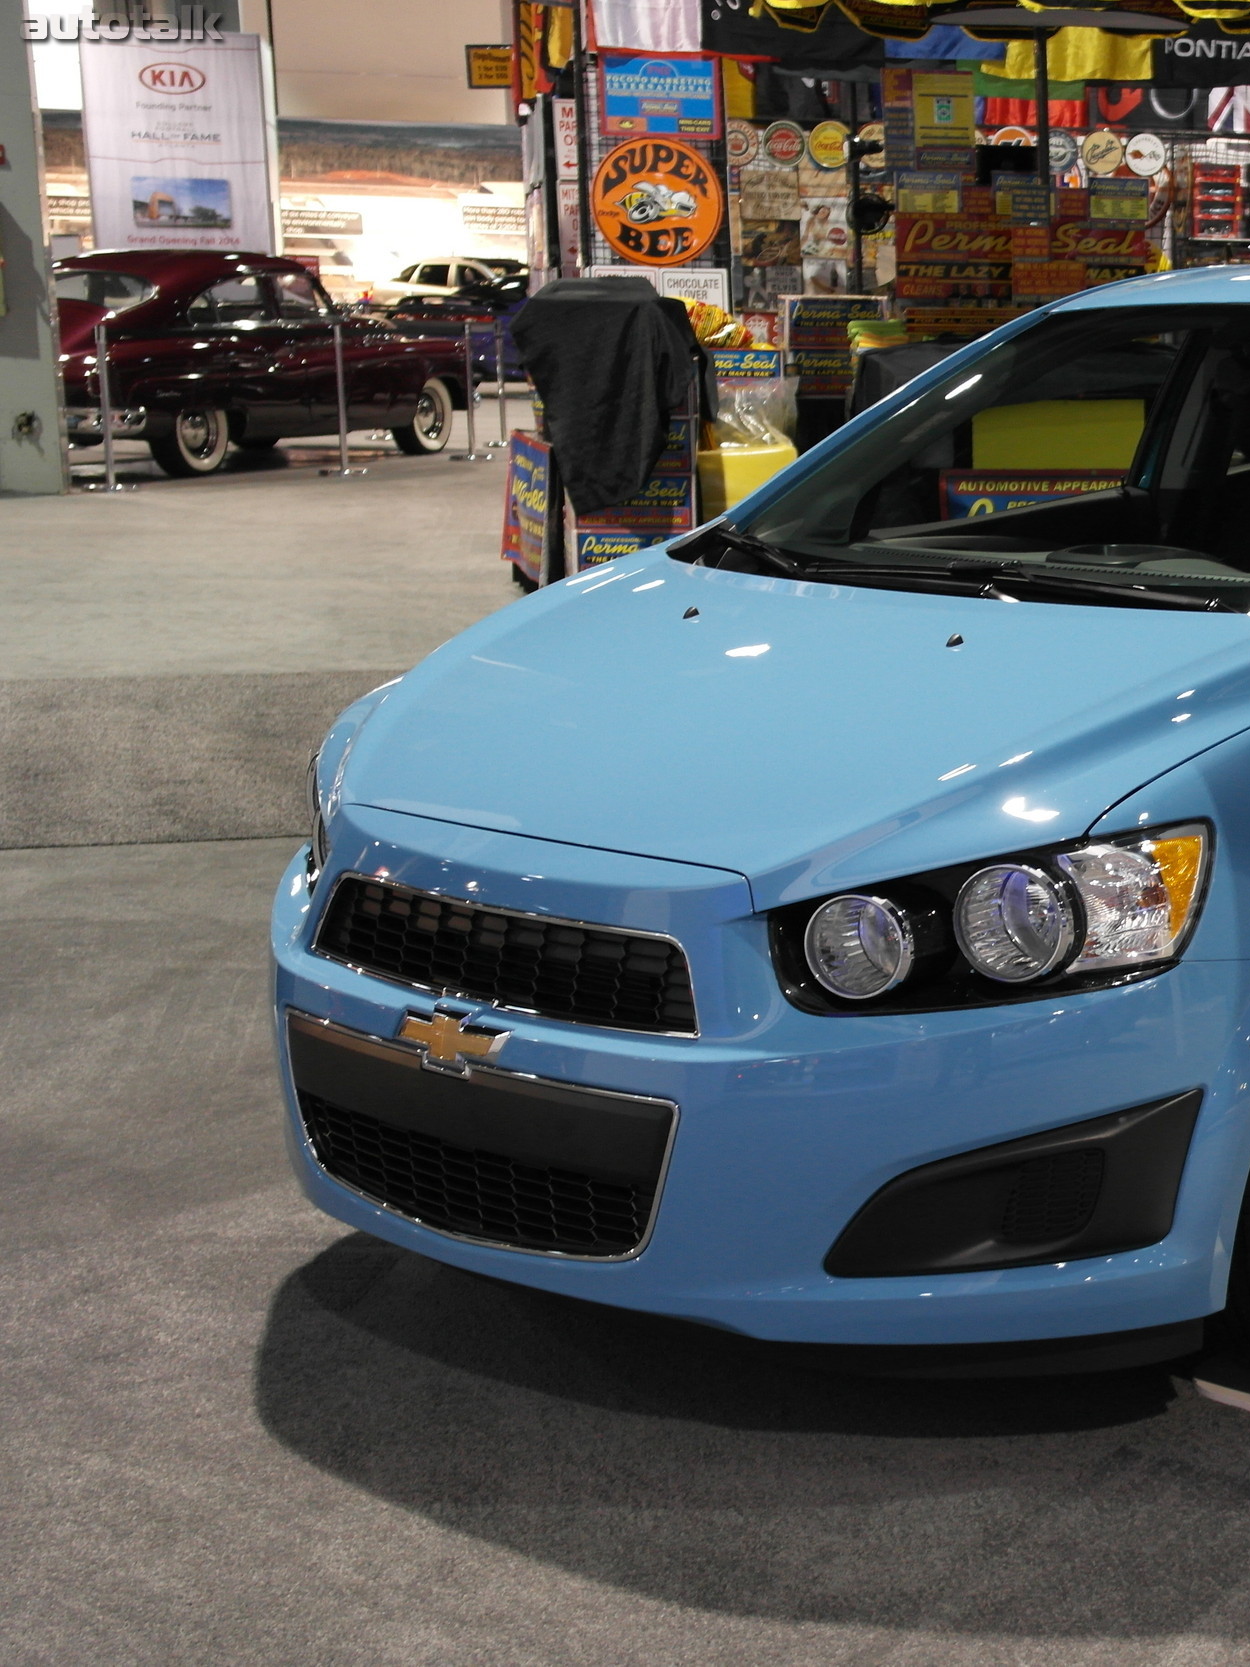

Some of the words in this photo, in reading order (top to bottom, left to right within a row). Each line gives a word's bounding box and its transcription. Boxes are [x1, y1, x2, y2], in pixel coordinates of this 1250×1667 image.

[150, 69, 196, 87] KIA
[650, 76, 712, 85] MARKETING
[606, 82, 712, 93] INTERNATIONAL
[135, 101, 177, 112] Founding
[178, 102, 213, 112] Partner
[131, 130, 170, 140] HALL
[183, 132, 222, 142] FAME
[601, 143, 709, 200] SUPER
[127, 235, 157, 245] Grand
[158, 236, 198, 246] Opening
[616, 222, 694, 258] BEE
[904, 219, 1012, 254] Perm
[949, 264, 1004, 278] LAZY
[666, 278, 720, 289] CHOCOLATE
[679, 289, 708, 301] LOVER
[793, 301, 882, 320] Perma-Seal
[957, 480, 1050, 492] AUTOMOTIVE
[1052, 480, 1127, 492] APPEARAN
